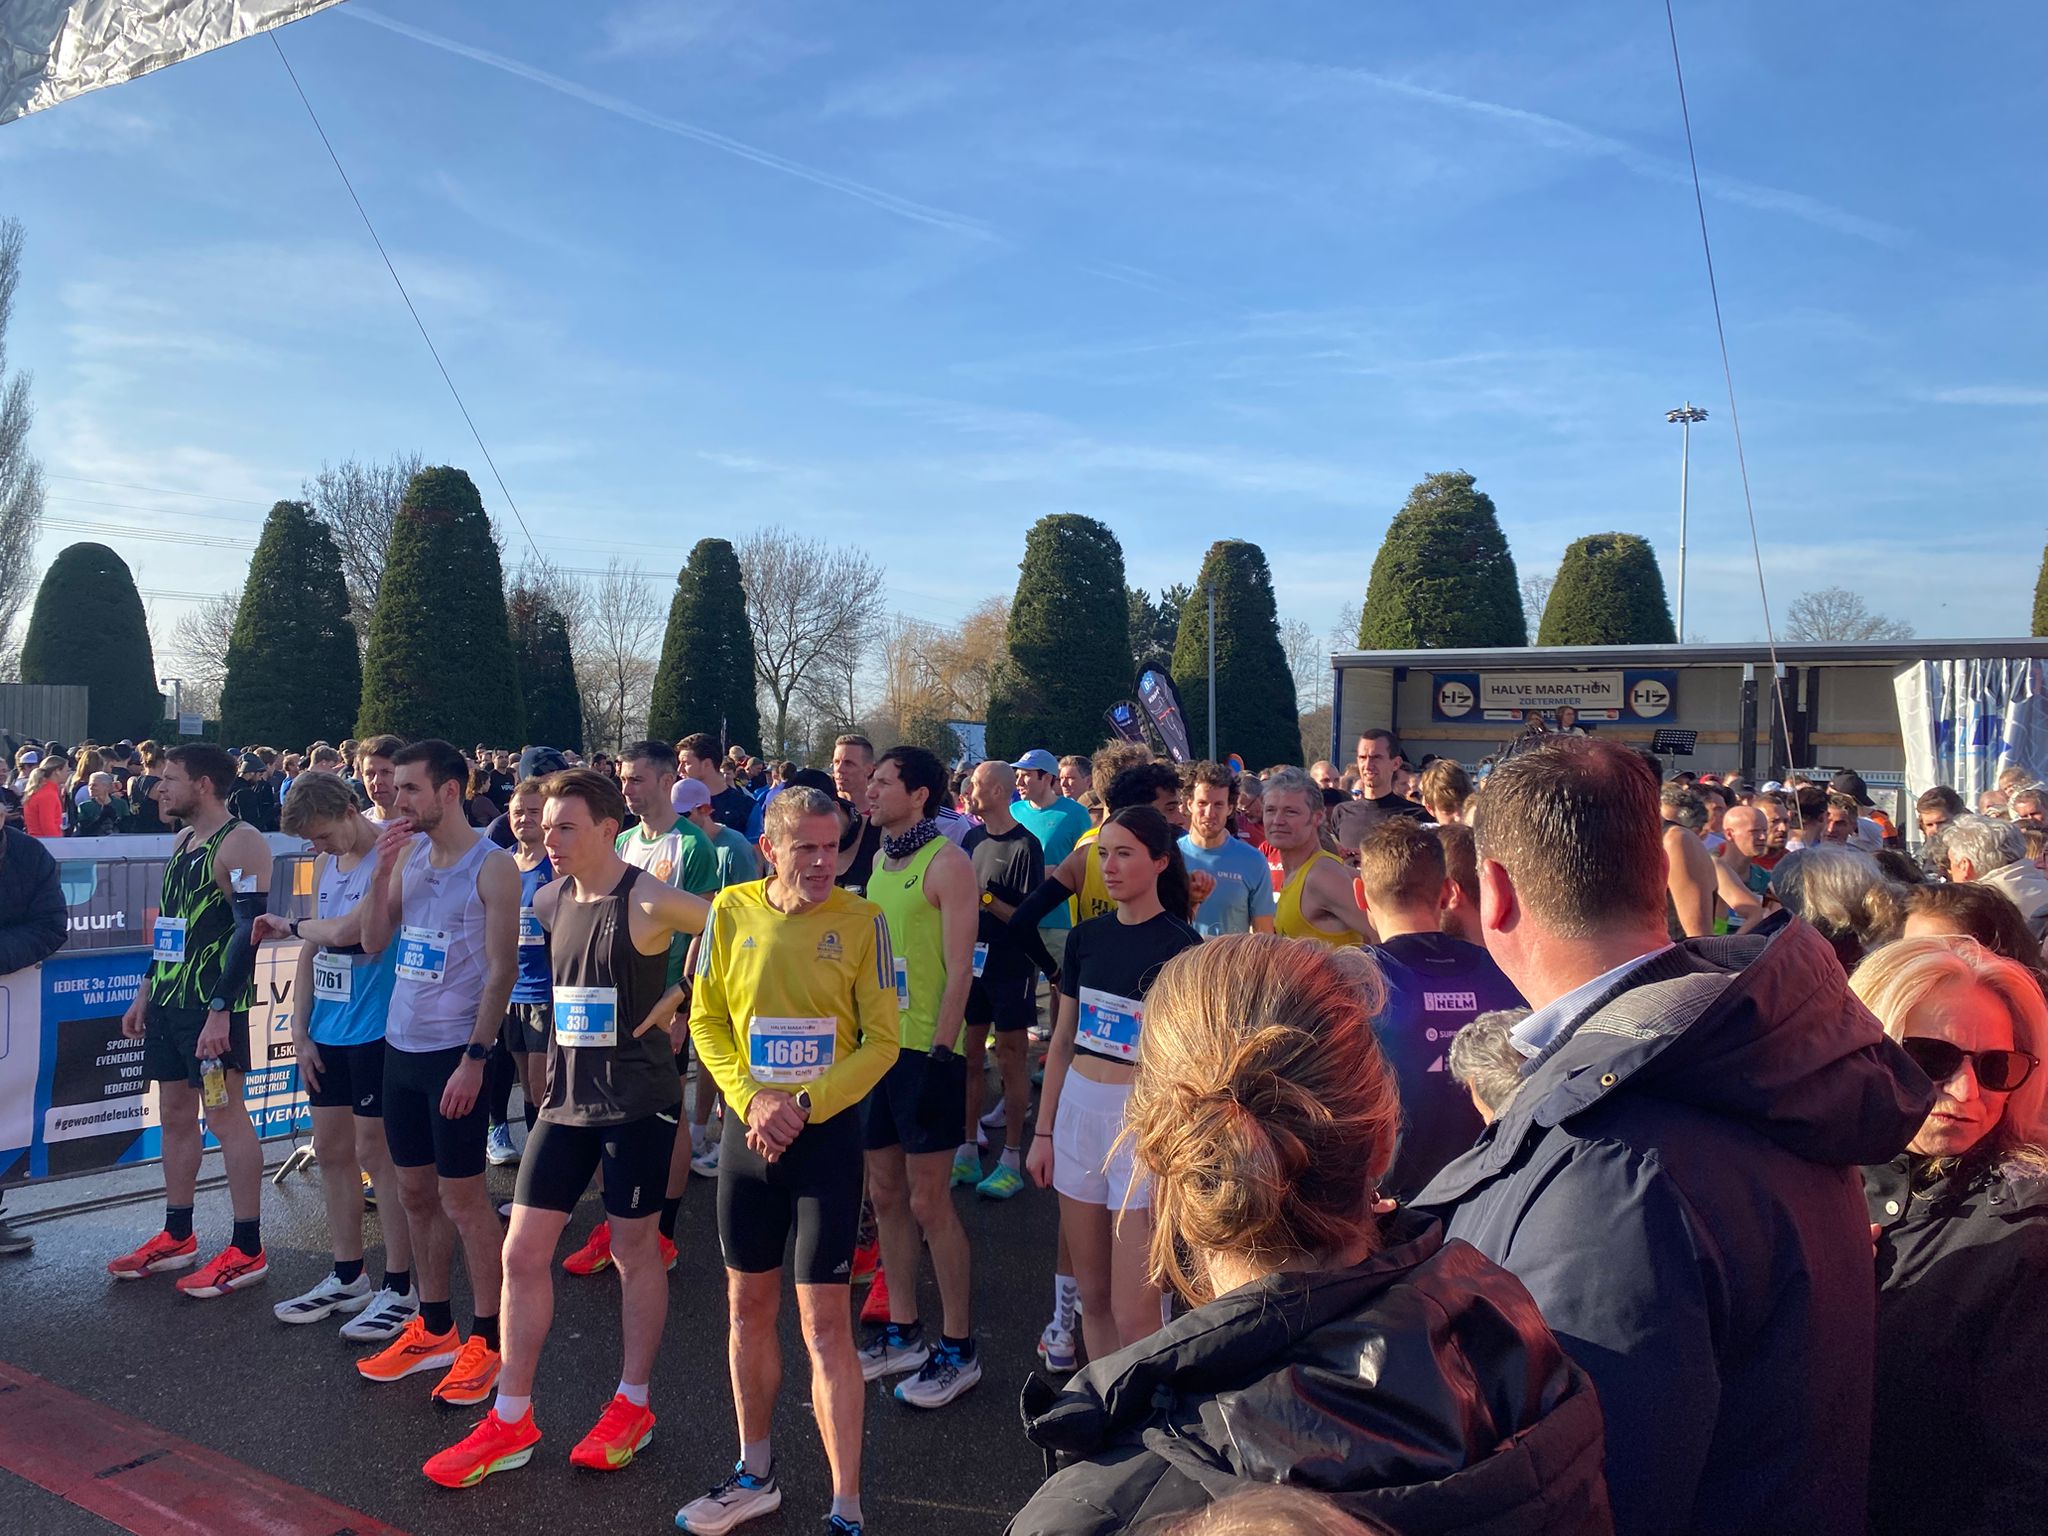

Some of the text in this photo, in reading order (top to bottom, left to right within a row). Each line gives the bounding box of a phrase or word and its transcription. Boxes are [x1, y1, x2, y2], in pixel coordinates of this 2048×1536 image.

[1491, 682, 1611, 695] HALVE MARATHON
[1519, 697, 1581, 706] ZOETERMEER
[54, 978, 90, 993] IEDERE
[92, 978, 105, 990] 3e
[83, 992, 104, 1005] VAN
[1436, 999, 1475, 1009] HELM
[566, 1014, 589, 1031] 330
[1096, 1021, 1112, 1038] 74
[95, 1050, 145, 1066] EVENEMENT
[764, 1039, 818, 1065] 1685
[245, 1070, 290, 1085] INDIVIDUELE
[248, 1081, 288, 1096] WEDSTRIJD
[54, 1105, 150, 1131] #gewoondeleukste
